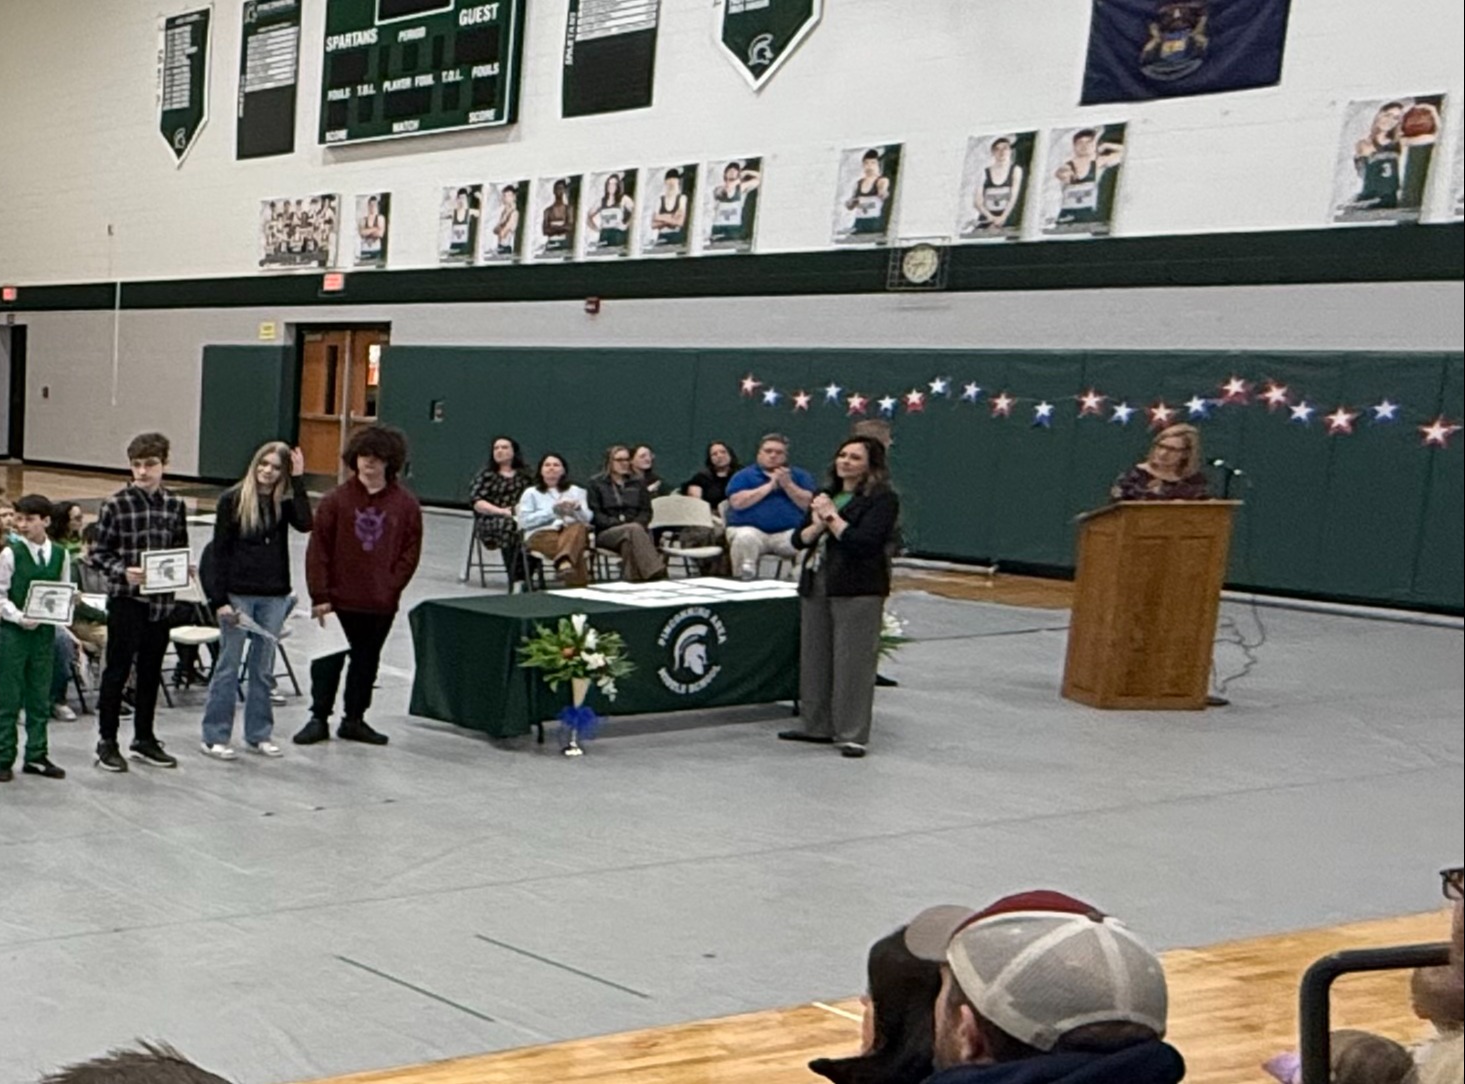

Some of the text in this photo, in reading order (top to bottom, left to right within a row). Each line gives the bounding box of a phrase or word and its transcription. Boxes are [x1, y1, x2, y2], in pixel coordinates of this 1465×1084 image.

[459, 3, 499, 26] GUEST
[326, 28, 378, 52] SPARTANS
[398, 26, 426, 42] PERIOD
[471, 62, 499, 79] FOULS
[1381, 162, 1393, 178] 3
[709, 614, 727, 645] AREA
